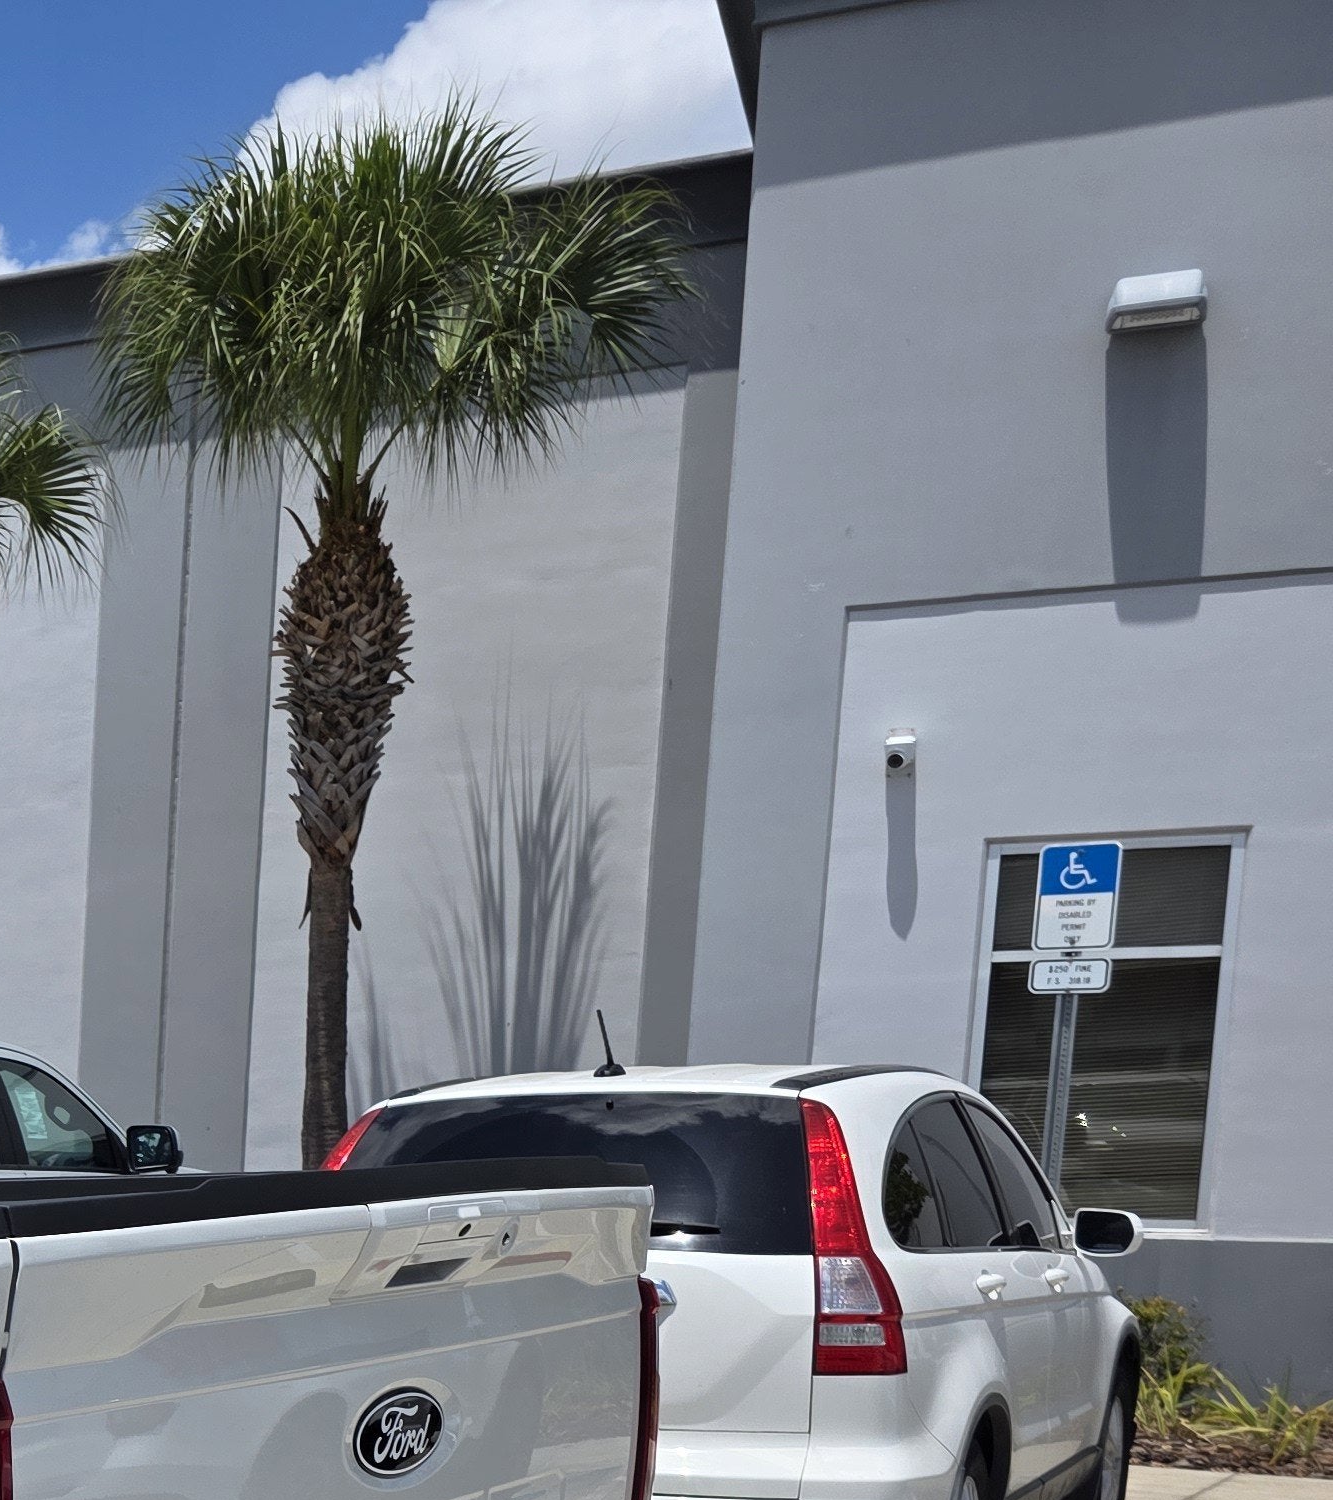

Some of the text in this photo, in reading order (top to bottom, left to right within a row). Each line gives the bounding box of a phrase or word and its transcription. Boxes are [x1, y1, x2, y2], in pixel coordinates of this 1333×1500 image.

[1056, 899, 1085, 907] PARKING
[1058, 911, 1092, 919] DISABLED
[1061, 923, 1087, 931] PERMIT
[374, 1404, 431, 1463] Ford
